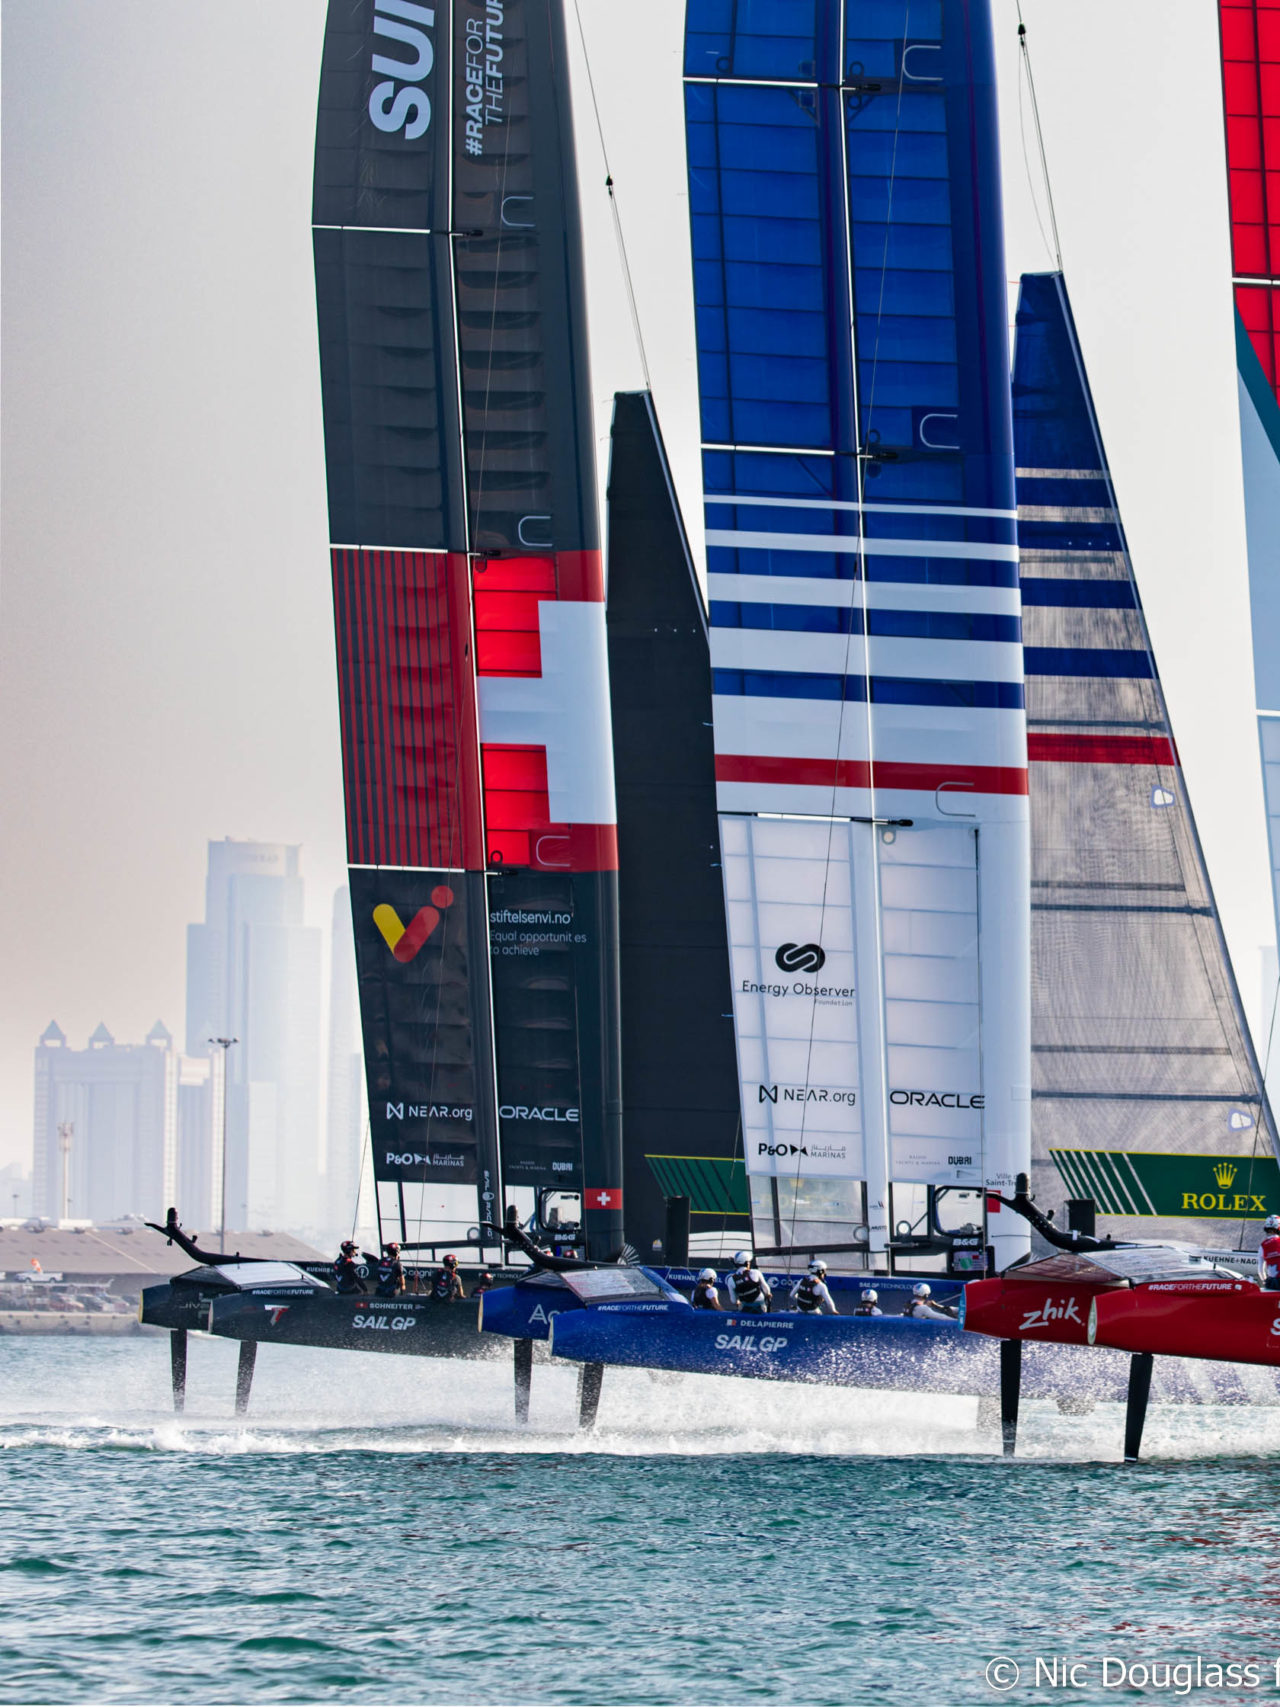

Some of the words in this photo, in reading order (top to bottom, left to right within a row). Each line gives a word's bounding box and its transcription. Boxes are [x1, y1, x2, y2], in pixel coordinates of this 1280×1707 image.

[368, 0, 435, 140] SUI
[465, 18, 483, 156] #RACEFOR
[490, 909, 571, 925] stiftelsenvi.no
[502, 944, 540, 956] achieve
[742, 980, 789, 997] Energy
[793, 982, 856, 997] Observer
[784, 1088, 855, 1106] NEAR.org
[889, 1090, 985, 1109] ORACLE
[408, 1105, 473, 1121] NEAR.org
[499, 1104, 579, 1122] ORACLE
[758, 1143, 788, 1156] P&O
[811, 1151, 846, 1159] MARINAS
[386, 1152, 413, 1166] P&O
[433, 1159, 464, 1167] MARINAS
[1181, 1192, 1267, 1212] ROLEX
[952, 1238, 979, 1246] B&G
[1204, 1256, 1259, 1265] KUEHNE+NAG
[740, 1320, 794, 1329] DELAPIERRE
